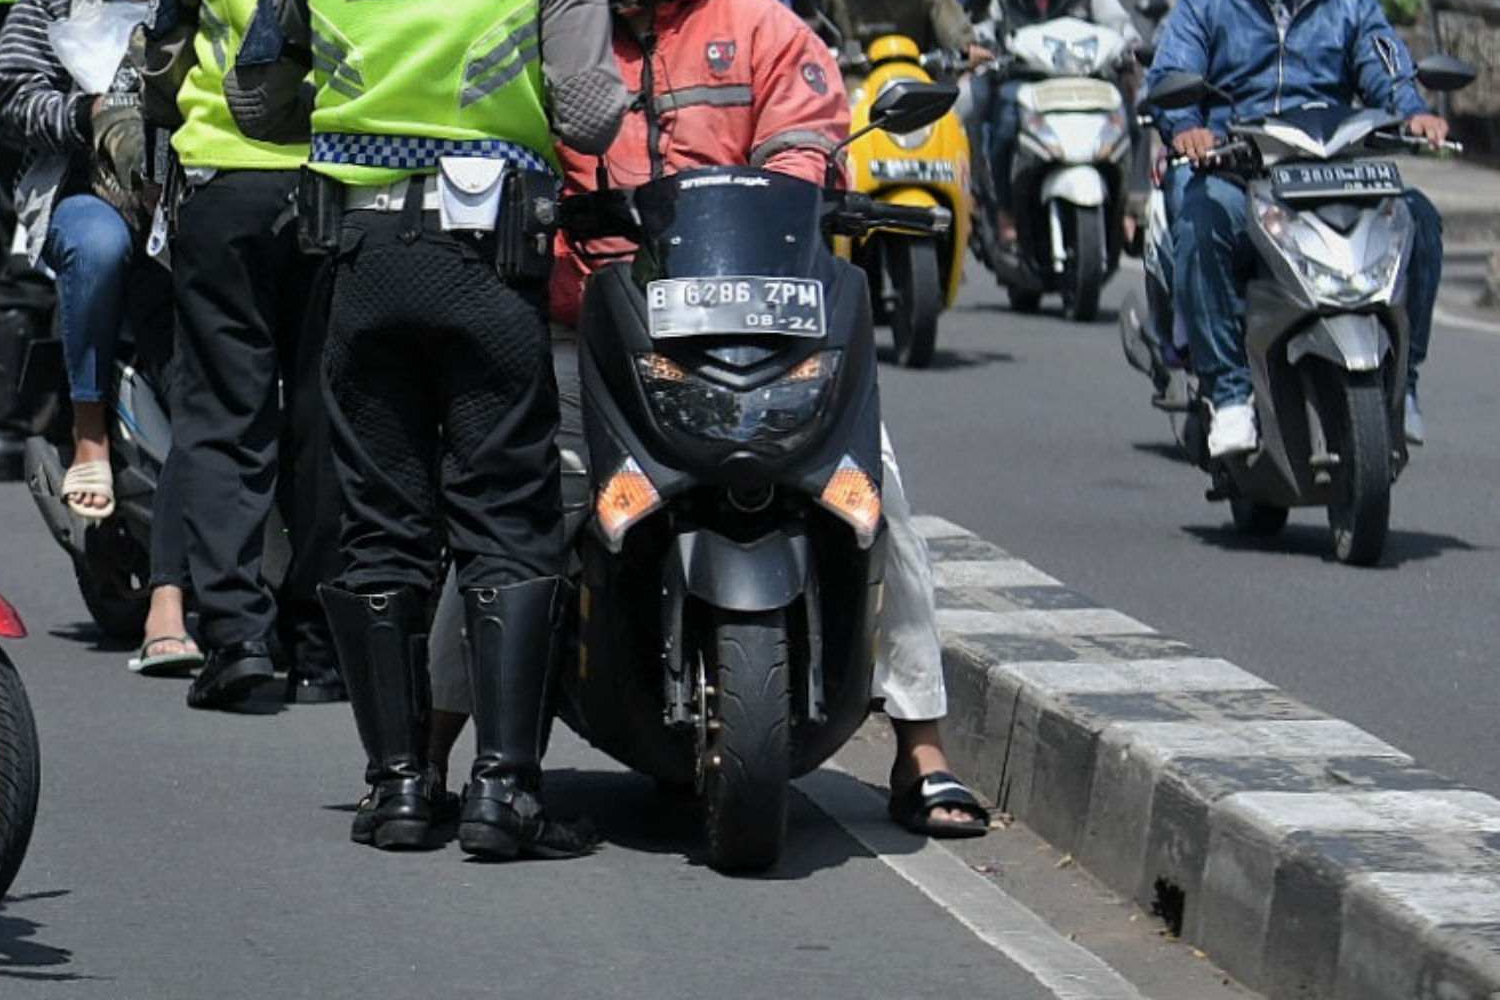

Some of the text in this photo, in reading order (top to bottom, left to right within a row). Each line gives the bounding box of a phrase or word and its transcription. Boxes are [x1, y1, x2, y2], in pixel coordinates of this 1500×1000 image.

[652, 283, 818, 309] B 6286 ZPM
[746, 315, 817, 331] 08-24
